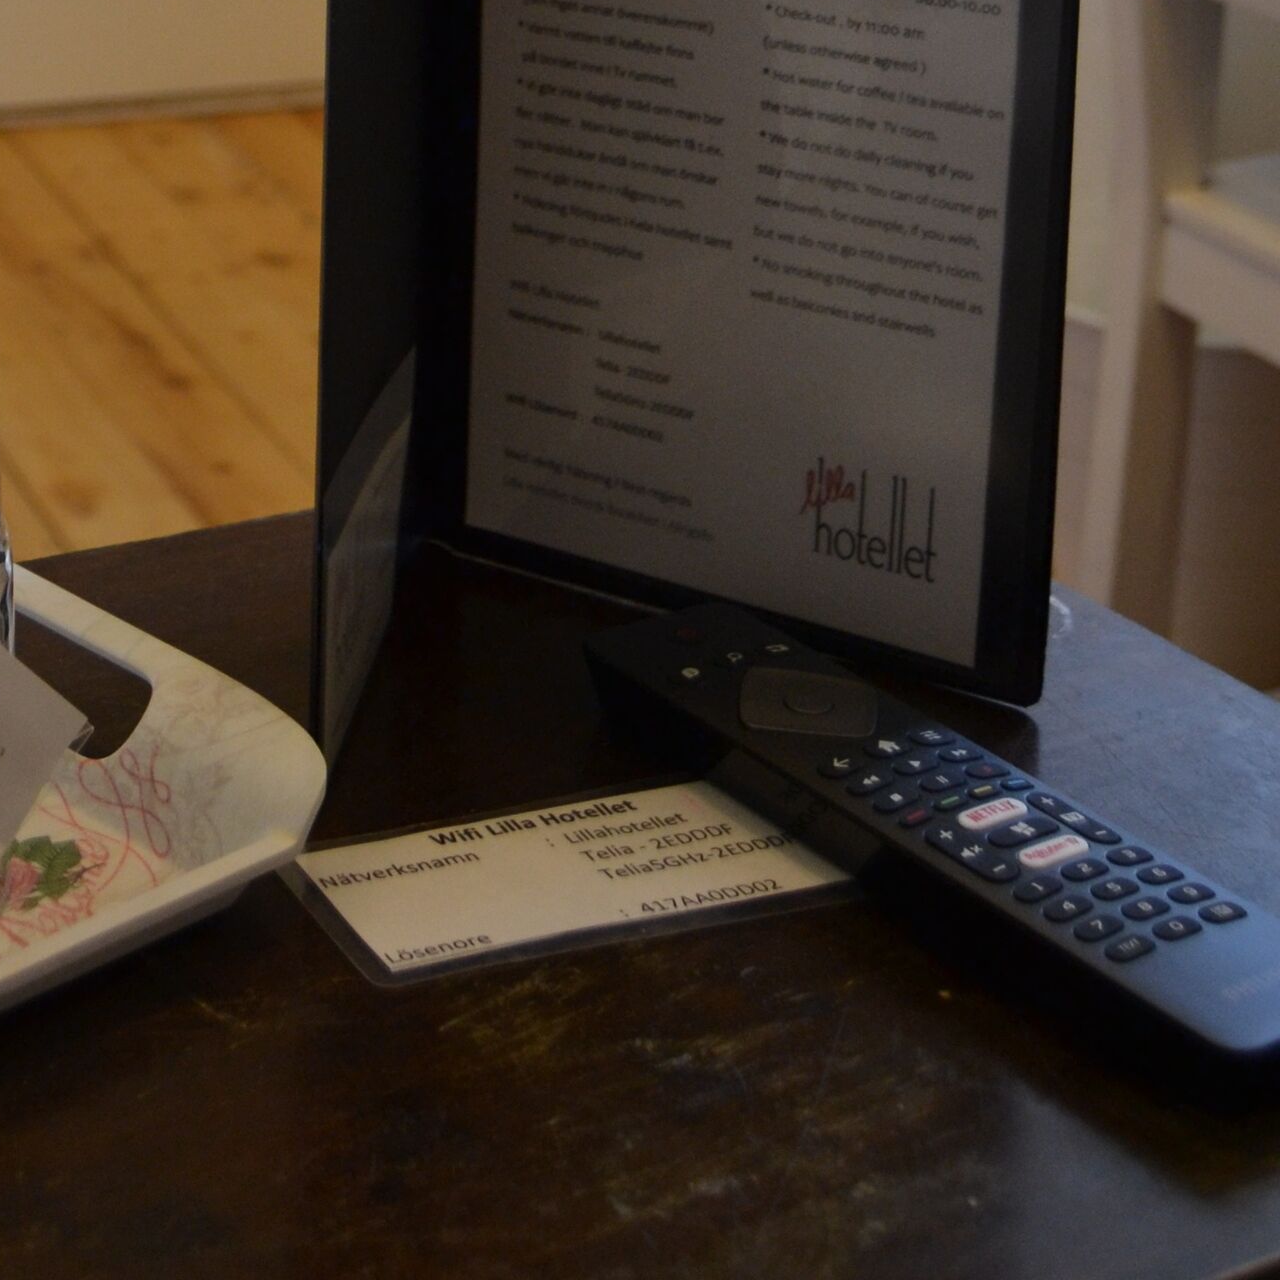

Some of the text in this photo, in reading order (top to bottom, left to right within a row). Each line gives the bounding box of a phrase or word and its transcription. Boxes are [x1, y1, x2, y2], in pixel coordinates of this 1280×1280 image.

[846, 17, 861, 31] by
[865, 21, 899, 36] 11:00
[902, 27, 923, 38] am
[762, 34, 917, 72] (unless otherwise agreed
[772, 70, 1004, 119] Hot water for coffee tea available on
[760, 99, 780, 113] the
[782, 104, 814, 118] table
[817, 111, 852, 126] inside
[855, 116, 876, 130] the
[768, 132, 973, 181] We do not do daily cleaning if you
[757, 163, 782, 179] stay
[784, 169, 816, 182] more
[865, 184, 886, 197] You
[889, 190, 912, 200] can
[914, 194, 928, 204] of
[931, 198, 973, 213] course
[976, 206, 997, 219] get
[755, 195, 781, 207] new
[831, 208, 848, 220] for
[850, 215, 903, 232] example,
[911, 224, 919, 234] if
[922, 230, 944, 241] you
[753, 225, 773, 238] but
[777, 233, 794, 243] we
[797, 235, 813, 247] do
[817, 240, 837, 251] not
[839, 245, 857, 258] go
[859, 249, 884, 261] into
[886, 254, 942, 273] anyone's
[762, 258, 983, 314] No smoking throughout the hotel as
[750, 290, 774, 301] well
[775, 295, 789, 305] as
[851, 311, 875, 324] and
[814, 457, 936, 583] hotellet
[427, 799, 638, 845] Wifi Lilla Hotellet
[966, 800, 1017, 823] NETFLIX
[317, 852, 480, 889] Nätverksnamn
[562, 812, 688, 844] Lillahotellet
[578, 844, 635, 862] Telia
[648, 823, 732, 850] 2EDDDF
[1031, 882, 1044, 891] 1
[1077, 862, 1093, 873] 2
[1062, 900, 1077, 910] 4
[1089, 919, 1104, 931] 7
[1168, 920, 1184, 931] 0
